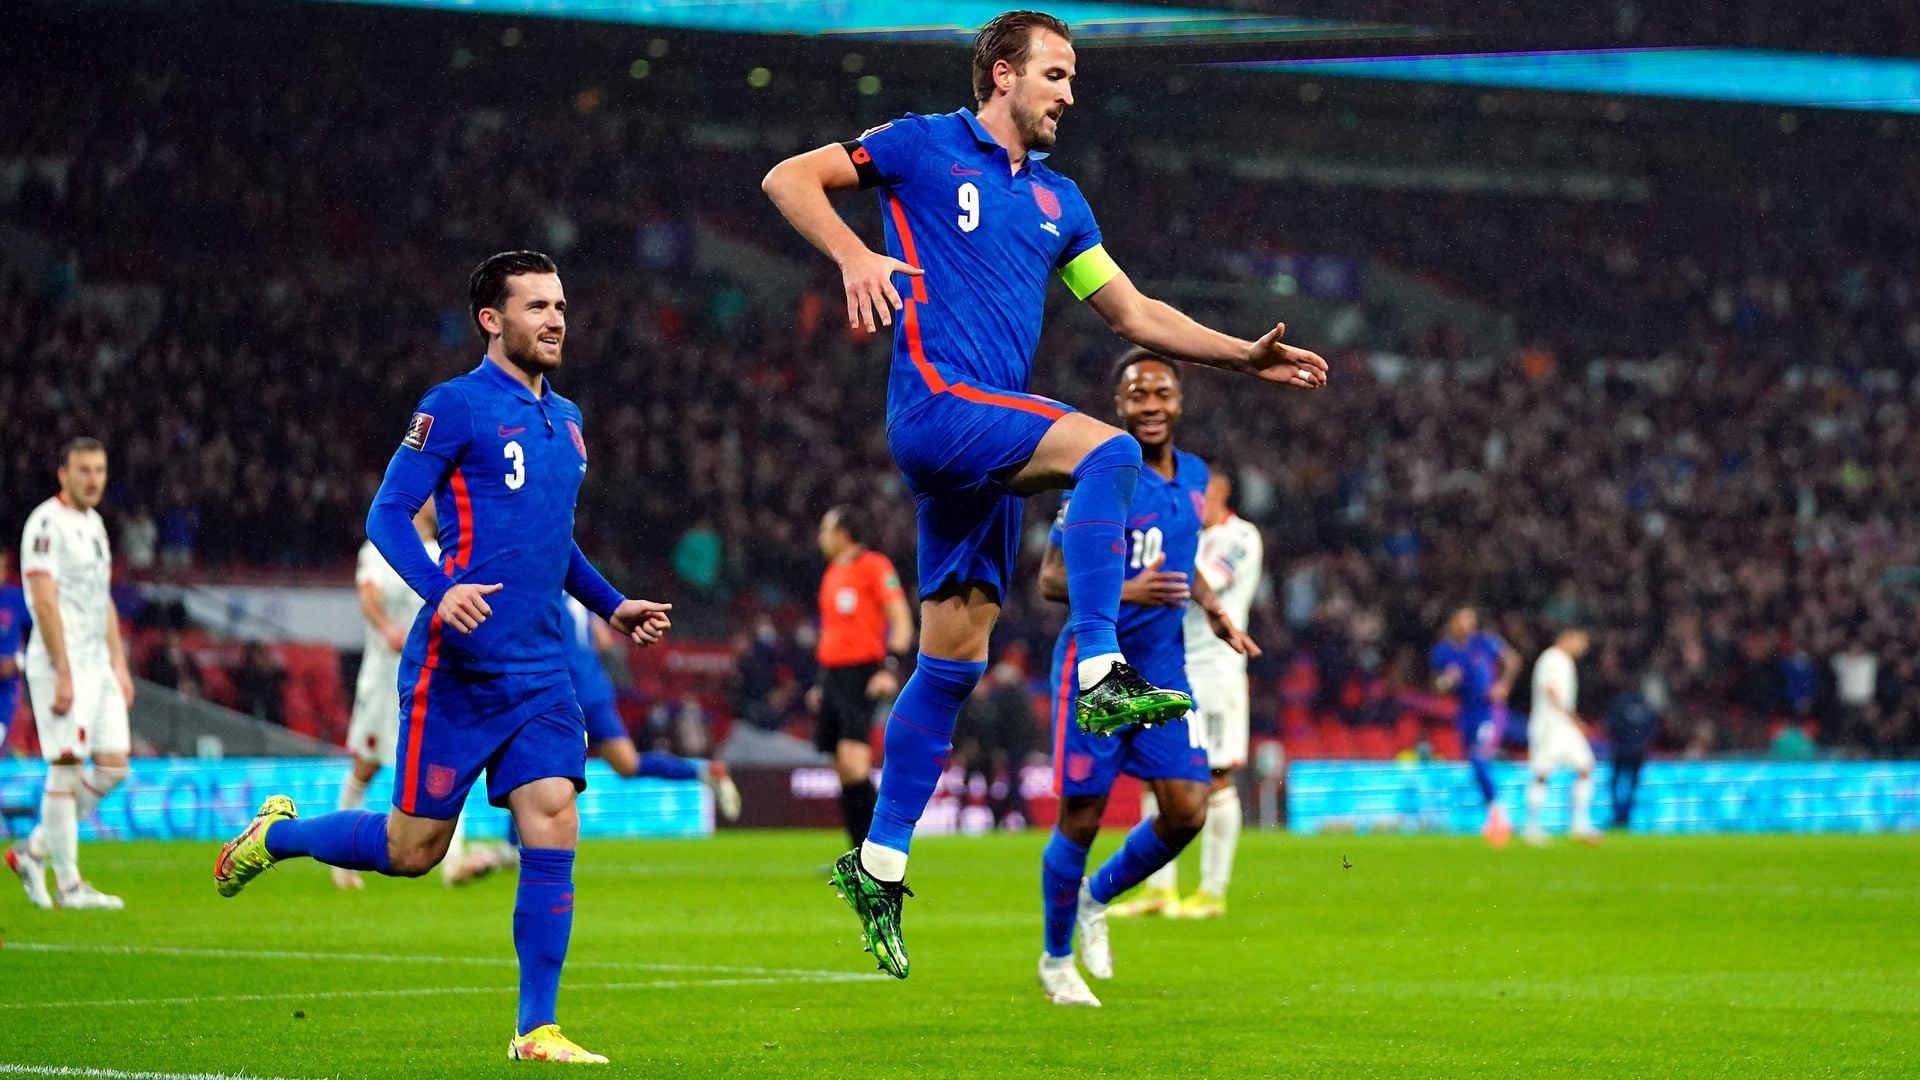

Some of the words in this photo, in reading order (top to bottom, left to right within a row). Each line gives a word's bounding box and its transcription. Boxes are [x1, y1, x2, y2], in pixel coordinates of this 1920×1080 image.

[957, 182, 980, 233] 9
[503, 440, 526, 491] 3
[1130, 526, 1163, 569] 10
